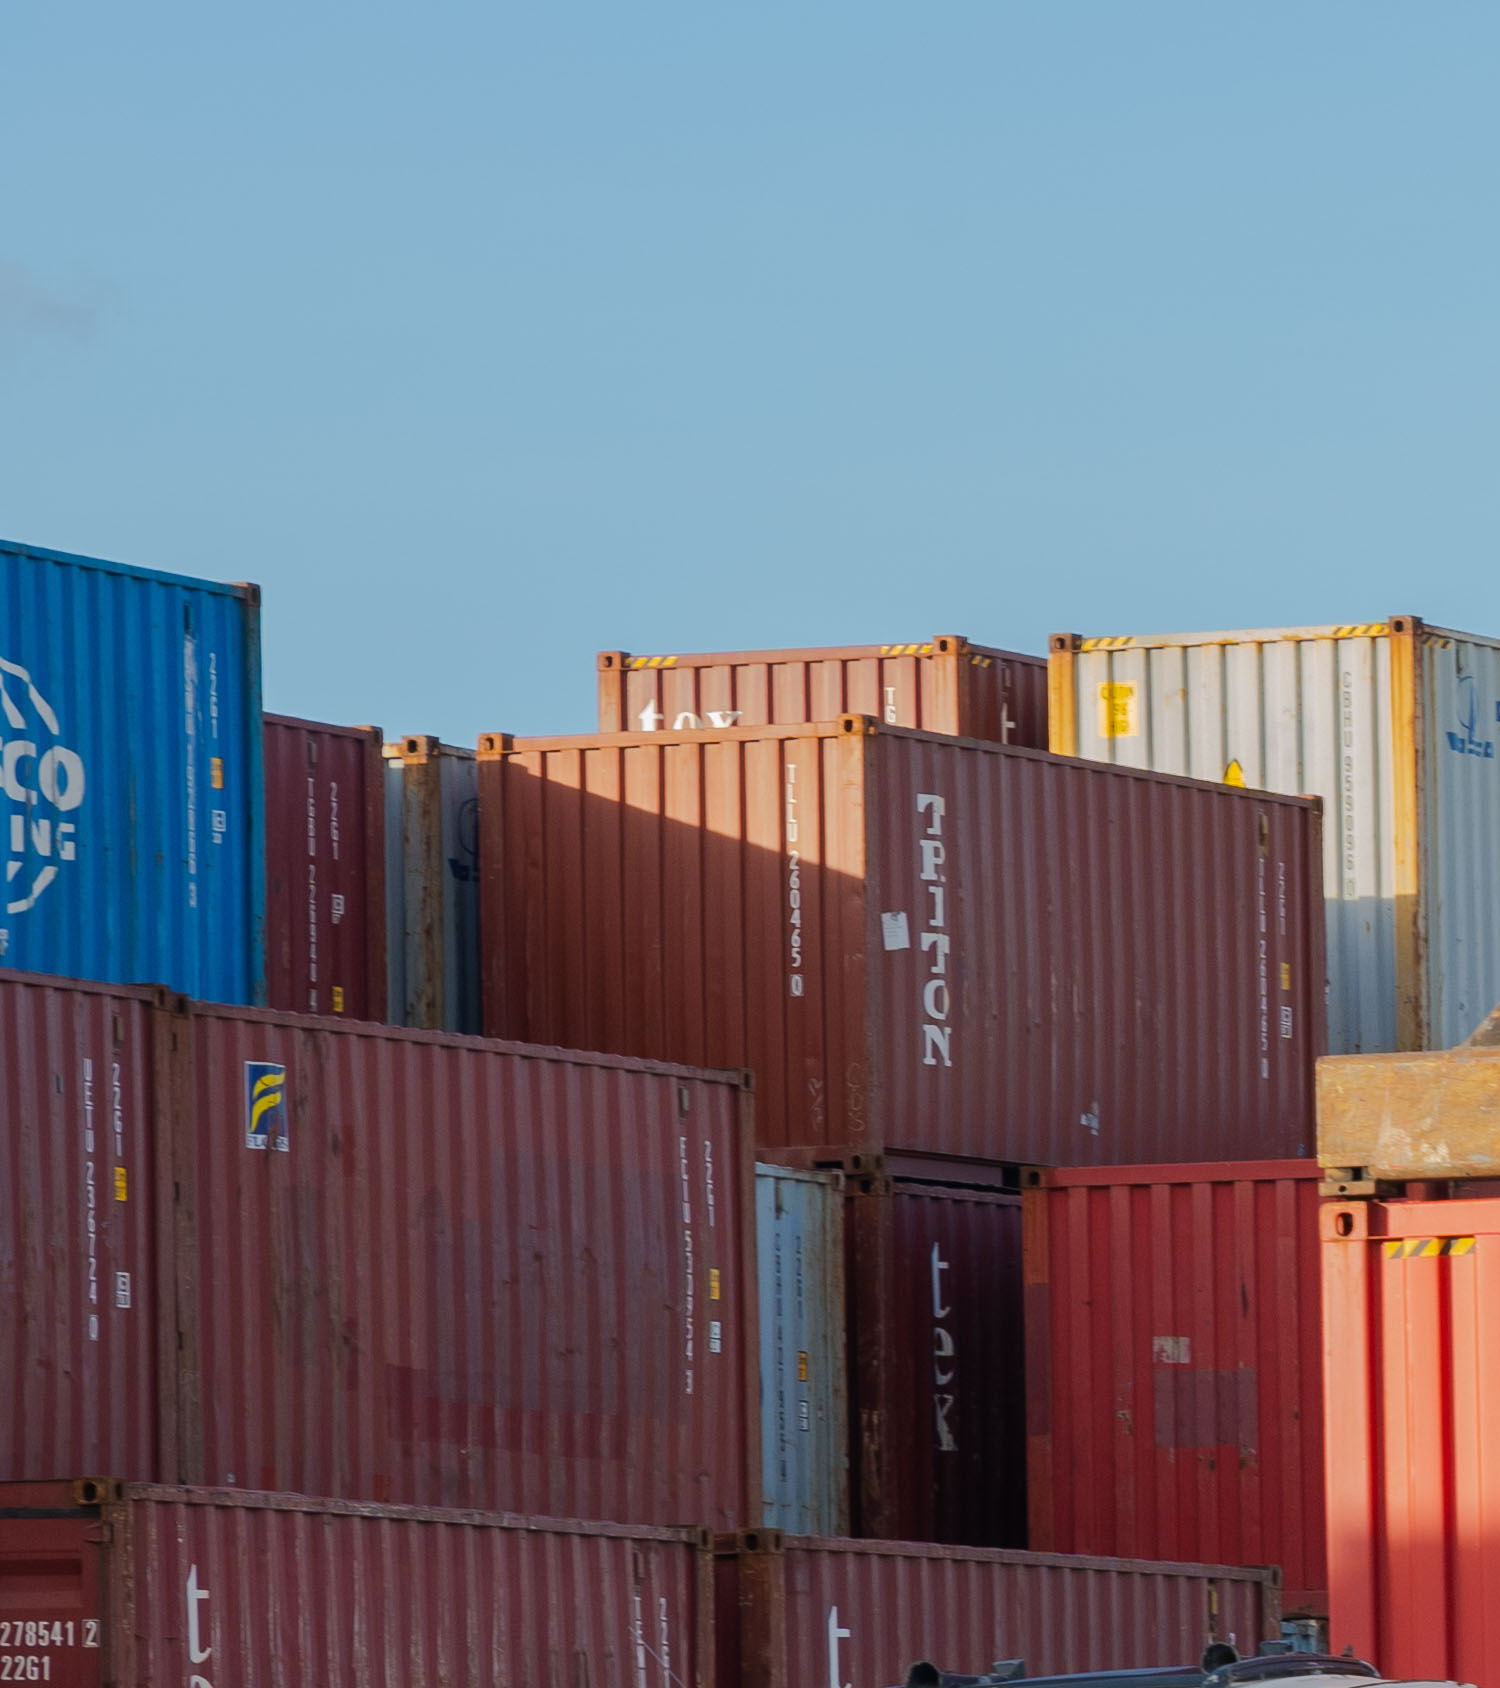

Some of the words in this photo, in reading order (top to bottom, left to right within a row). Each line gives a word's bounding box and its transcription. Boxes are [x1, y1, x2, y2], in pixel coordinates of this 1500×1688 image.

[786, 763, 798, 843] TLLU
[789, 850, 802, 968] 260465
[916, 793, 953, 1067] TRITON
[931, 1240, 959, 1452] tex
[0, 1620, 76, 1648] 278541
[81, 1618, 101, 1649] 2
[0, 1654, 52, 1682] 22G1
